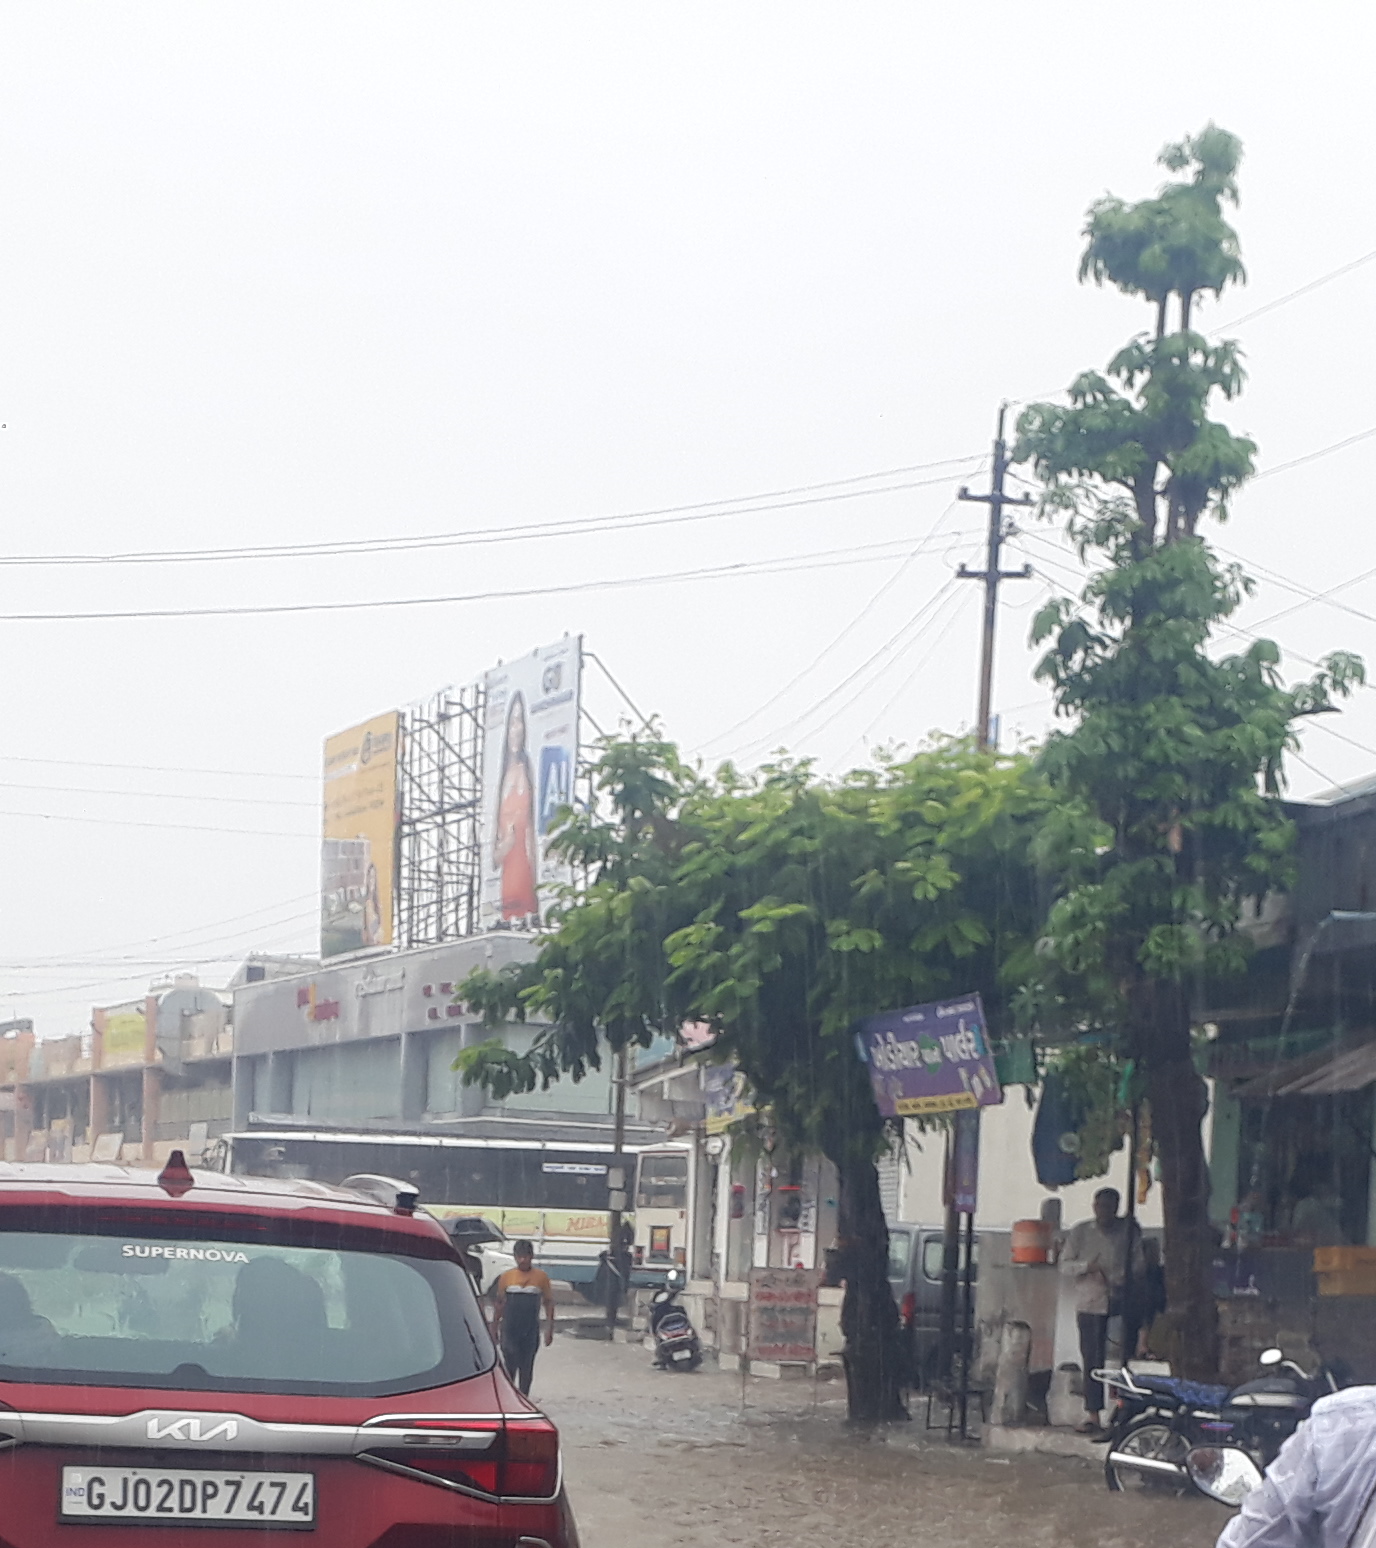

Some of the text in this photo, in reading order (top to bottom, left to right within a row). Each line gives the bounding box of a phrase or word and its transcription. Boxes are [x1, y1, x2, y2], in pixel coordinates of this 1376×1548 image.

[121, 1244, 250, 1264] SUPERNOVA
[146, 1417, 239, 1442] KIA
[85, 1475, 311, 1517] GJ02DP7474
